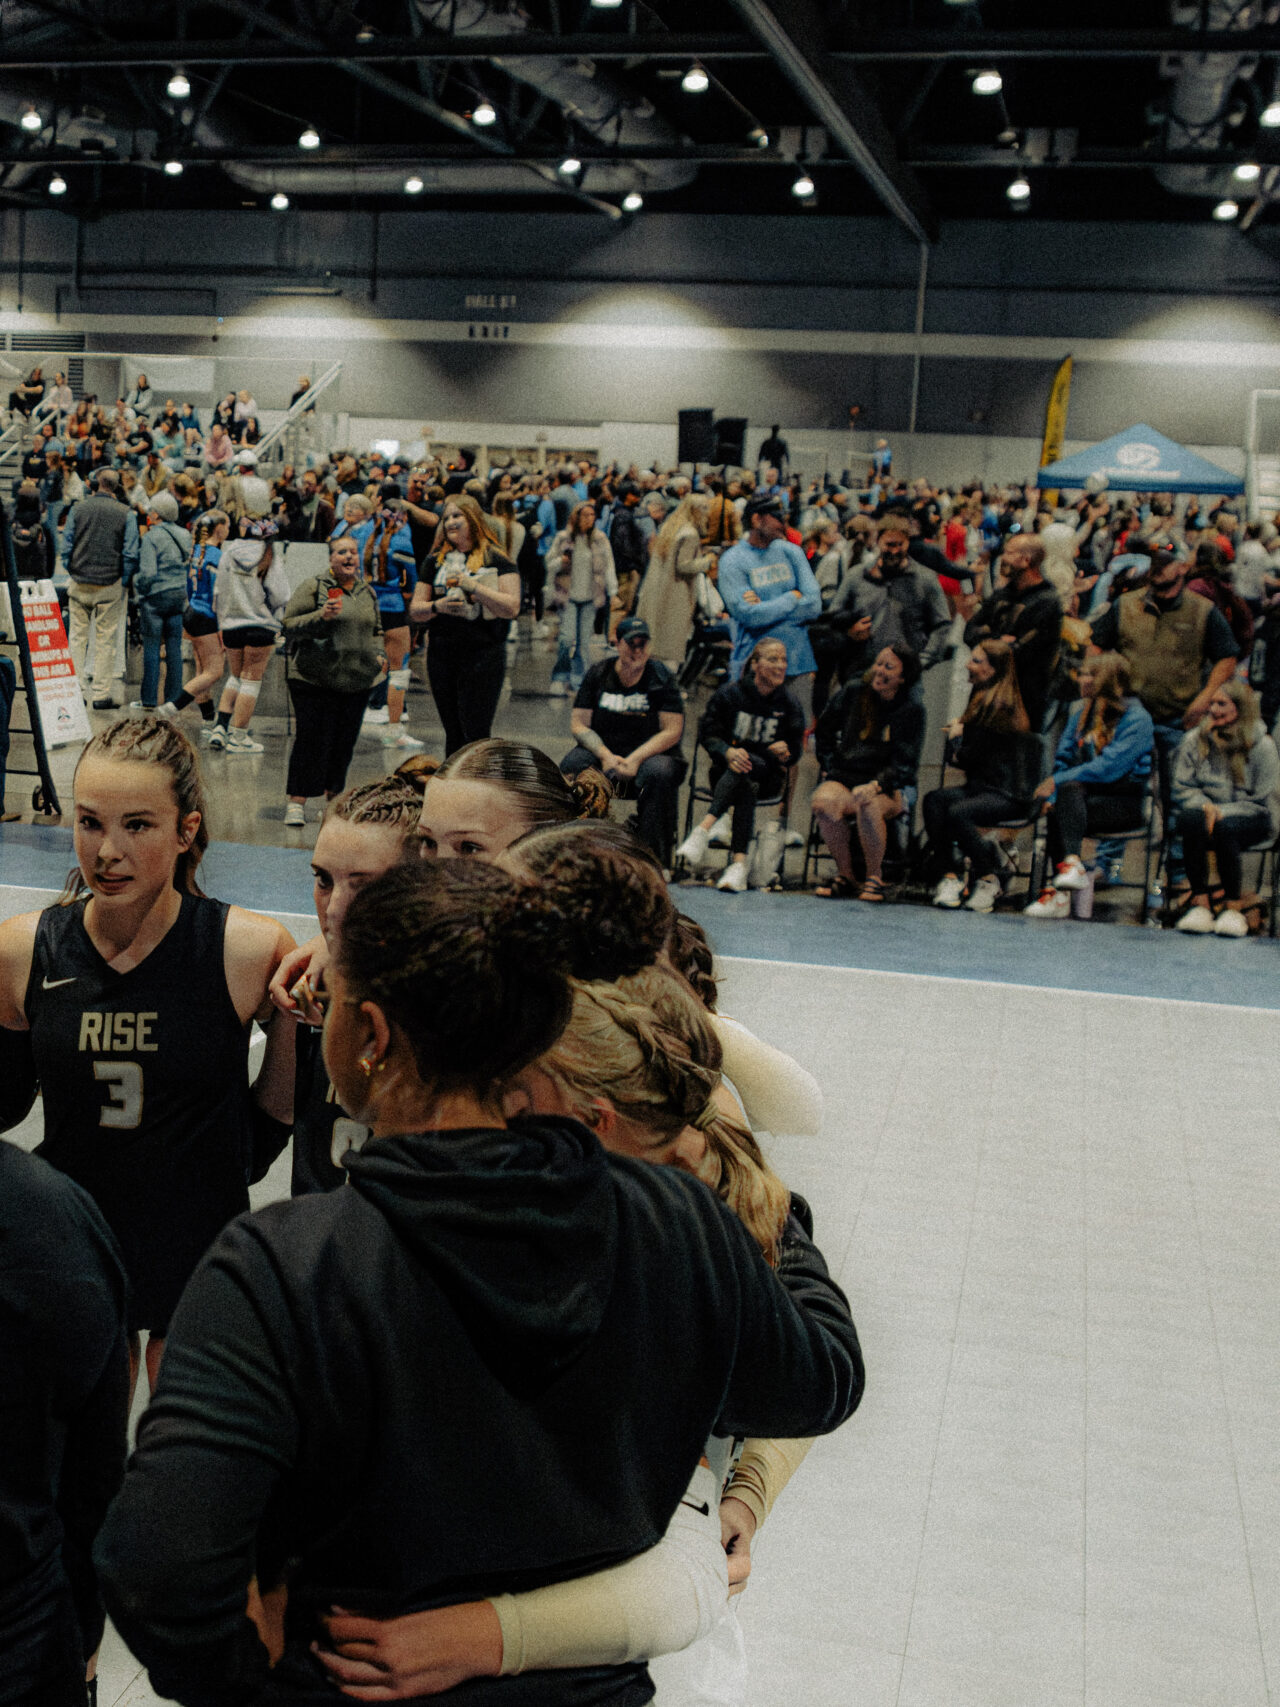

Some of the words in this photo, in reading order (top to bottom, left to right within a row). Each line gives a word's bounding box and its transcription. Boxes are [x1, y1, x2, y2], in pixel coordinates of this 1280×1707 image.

[468, 325, 509, 338] EXIT
[33, 603, 53, 617] BALL
[37, 634, 51, 648] OR
[51, 663, 72, 676] AREA
[78, 1011, 159, 1052] RISE
[93, 1061, 144, 1129] 3
